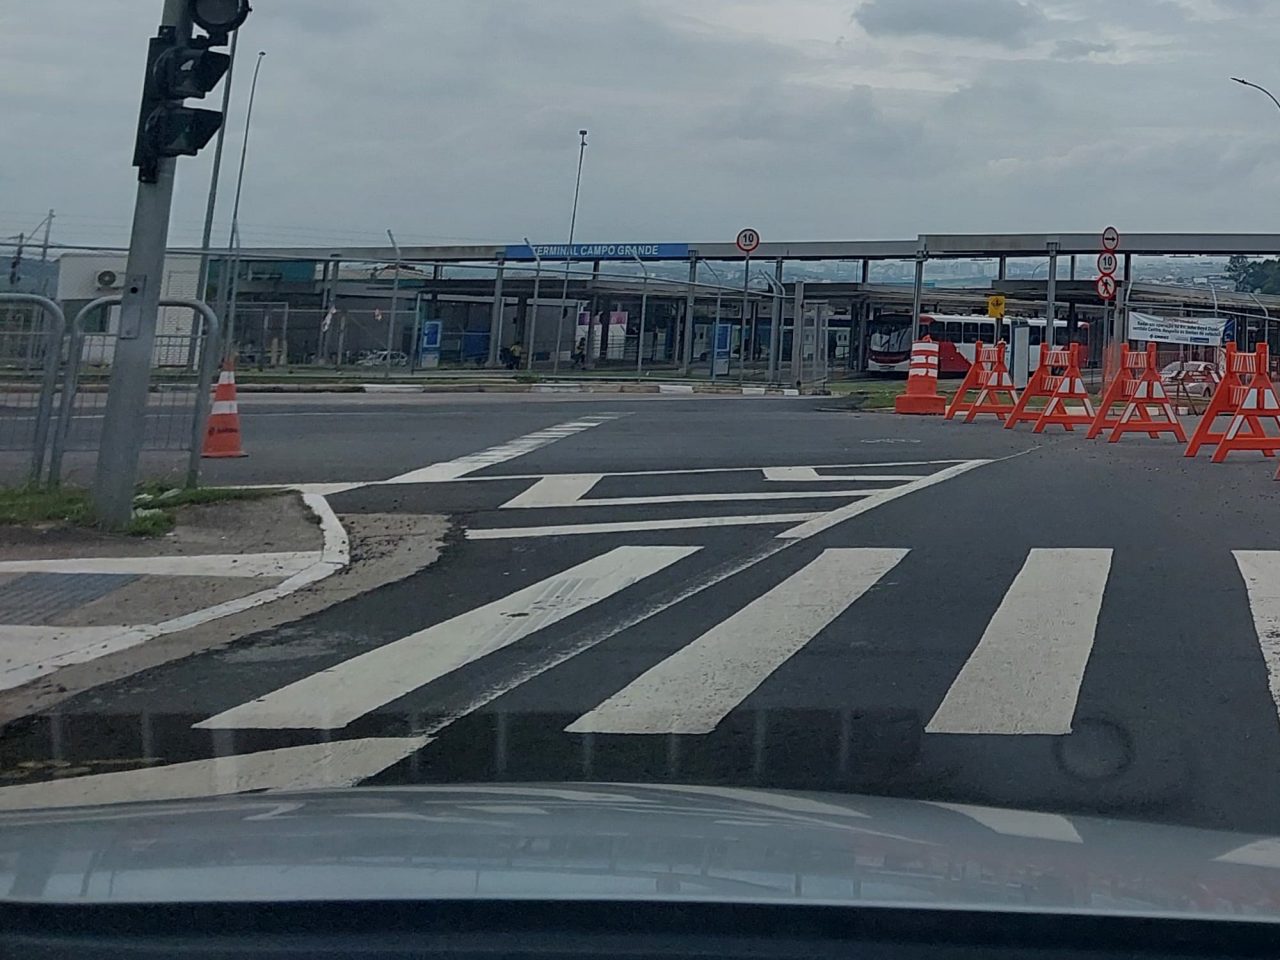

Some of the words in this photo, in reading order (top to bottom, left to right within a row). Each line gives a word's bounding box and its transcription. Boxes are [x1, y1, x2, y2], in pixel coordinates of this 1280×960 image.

[742, 233, 754, 243] 10
[532, 246, 578, 256] TERMINAL
[580, 246, 616, 256] CAMPO
[617, 245, 658, 256] GRANDE
[1102, 256, 1113, 267] 10
